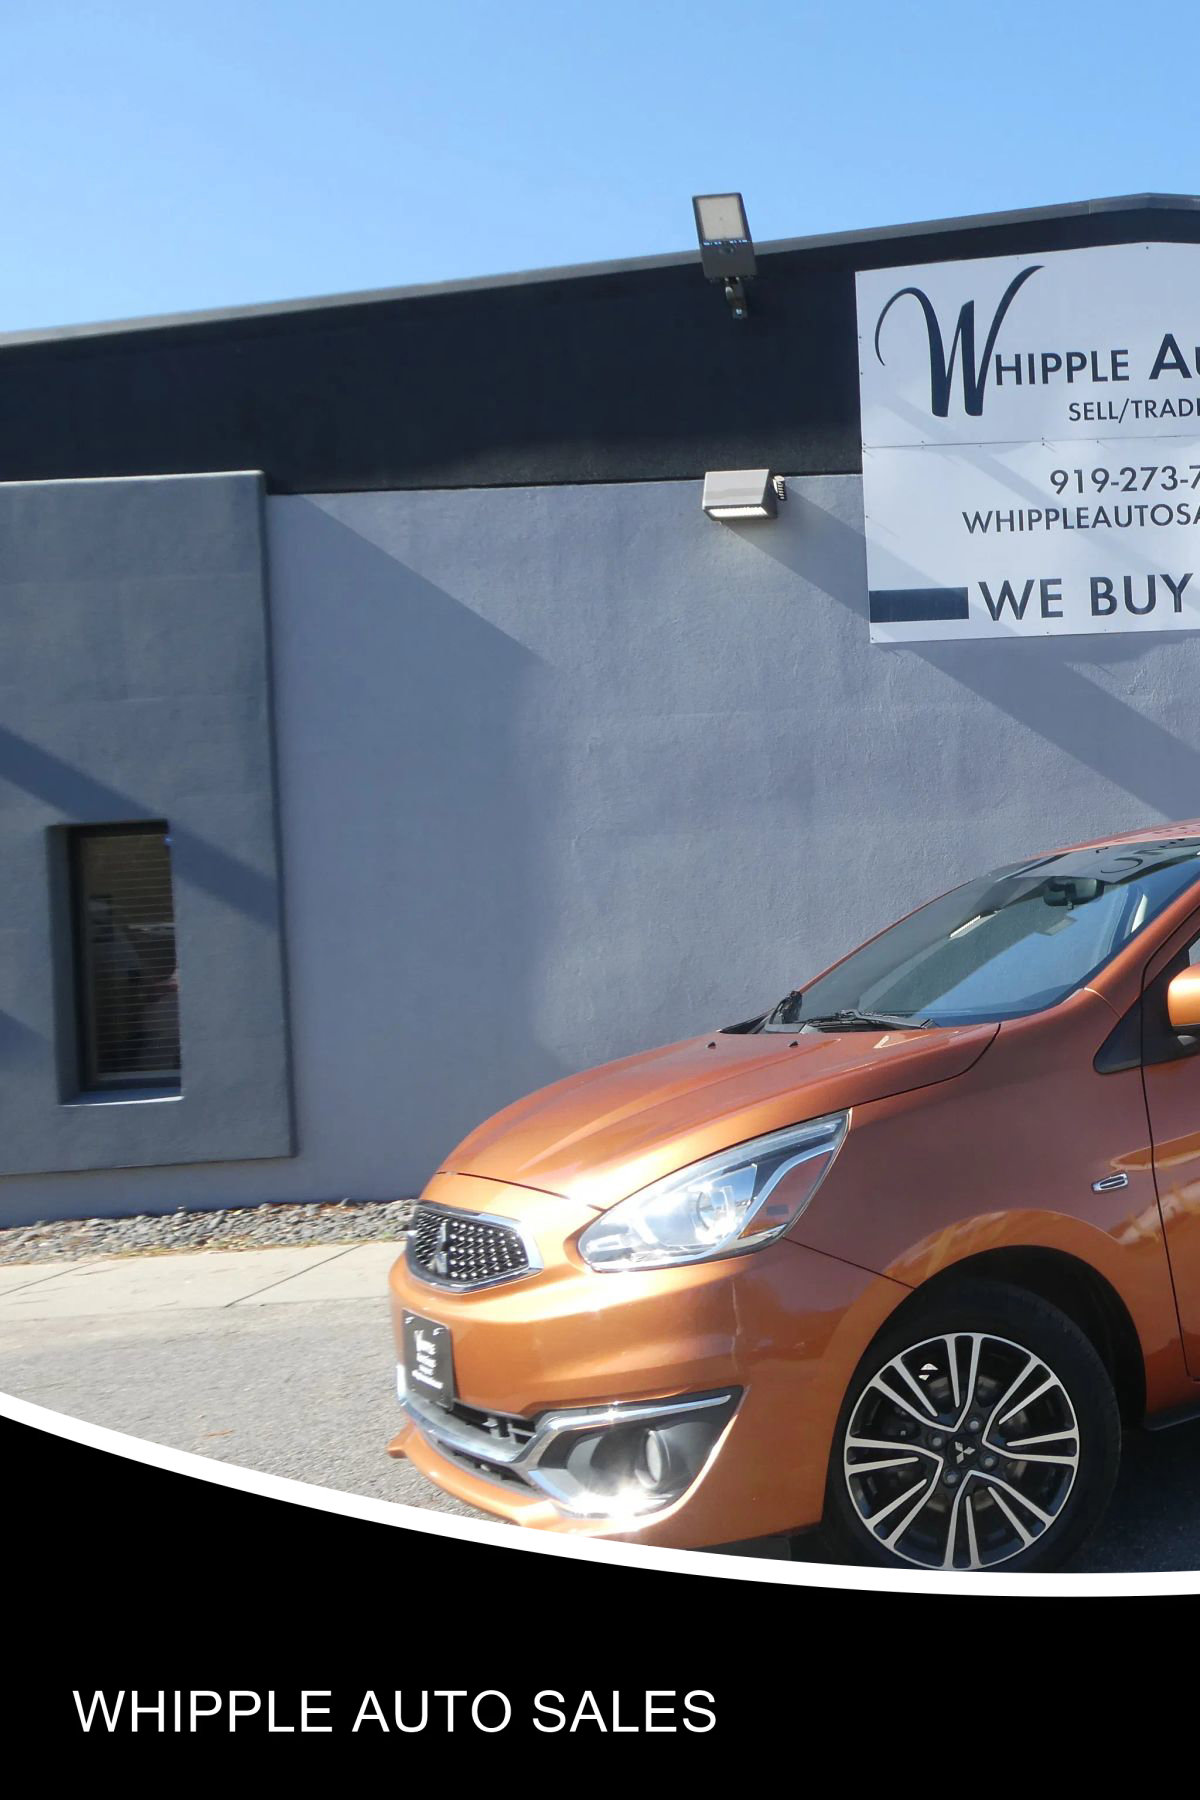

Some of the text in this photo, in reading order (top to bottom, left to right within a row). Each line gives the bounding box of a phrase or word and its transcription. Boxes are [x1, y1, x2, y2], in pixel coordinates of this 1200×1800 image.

[875, 265, 1130, 418] WHIPPLE
[978, 578, 1064, 622] WE
[1089, 573, 1193, 617] BUY
